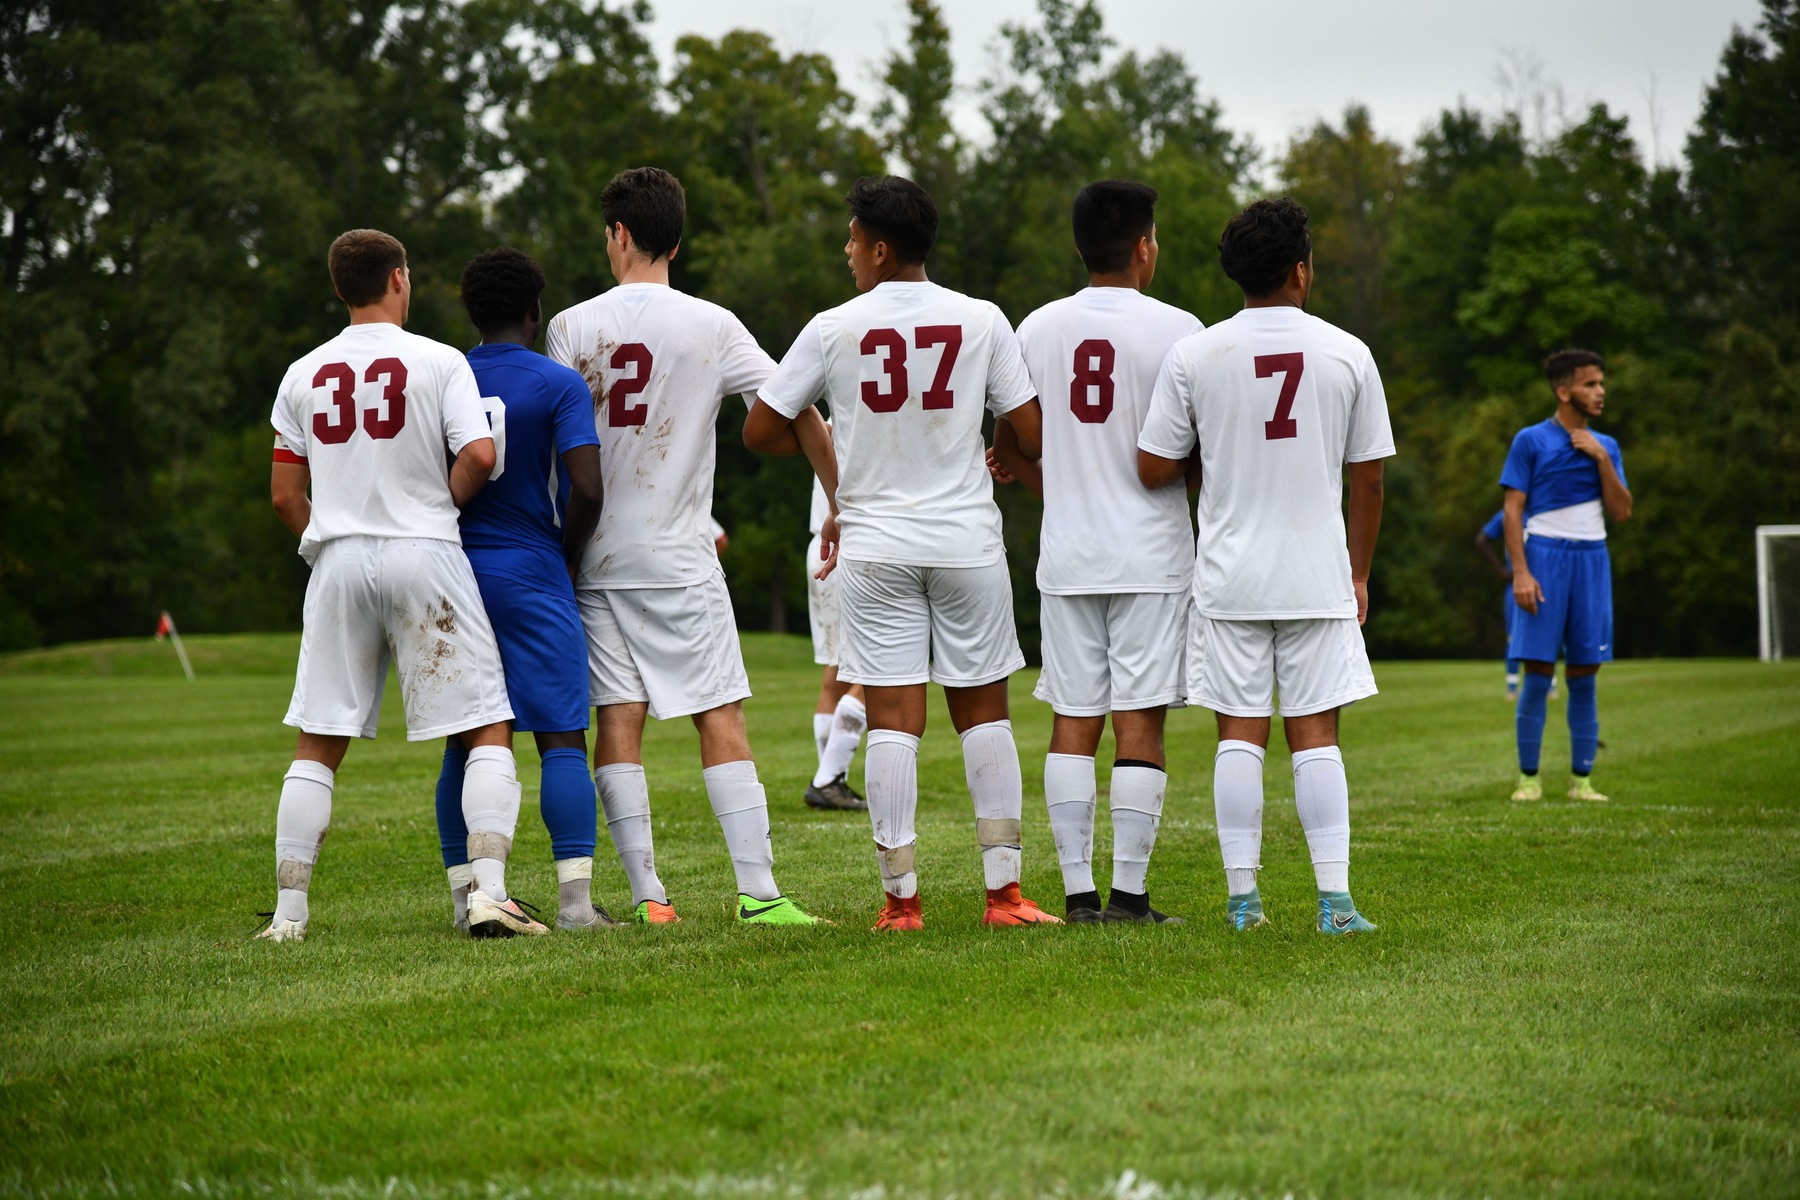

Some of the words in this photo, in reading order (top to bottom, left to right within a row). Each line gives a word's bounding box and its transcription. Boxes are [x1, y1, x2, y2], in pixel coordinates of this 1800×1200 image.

[312, 357, 408, 444] 33
[608, 343, 653, 427] 2
[860, 324, 963, 413] 37
[1070, 339, 1115, 424] 8
[1254, 352, 1304, 440] 7
